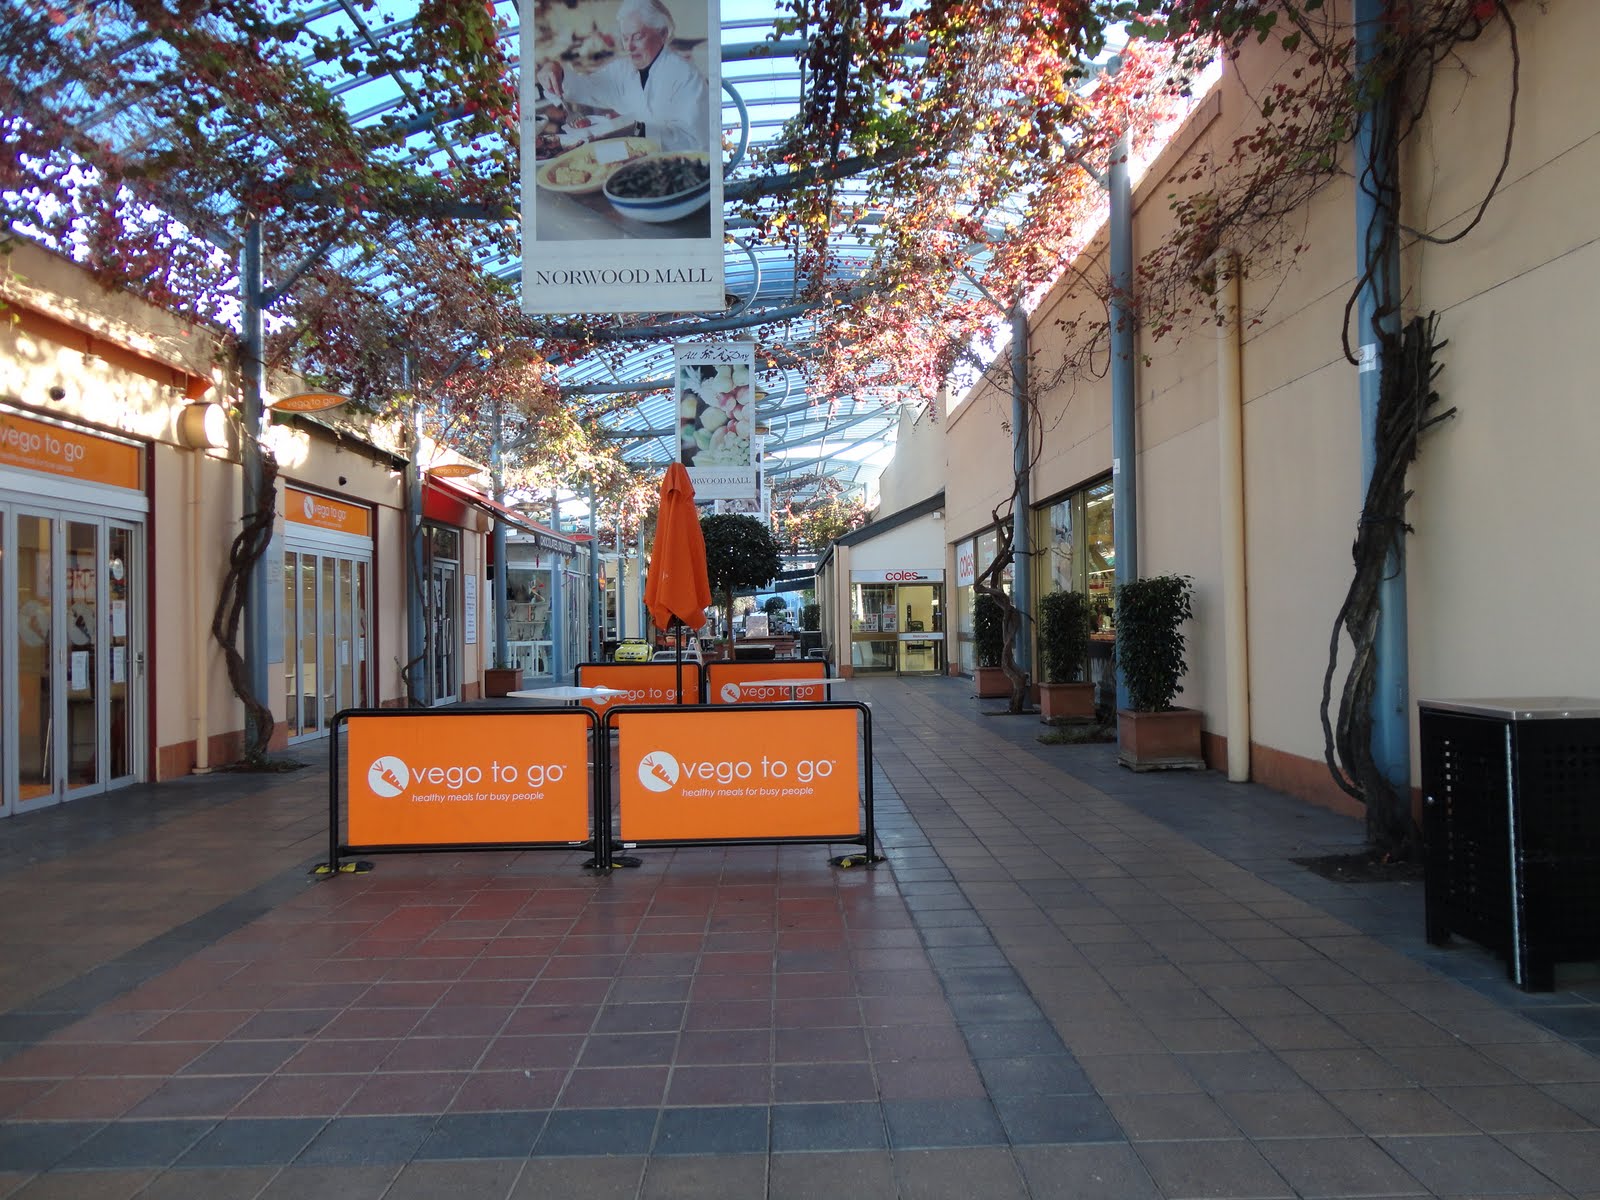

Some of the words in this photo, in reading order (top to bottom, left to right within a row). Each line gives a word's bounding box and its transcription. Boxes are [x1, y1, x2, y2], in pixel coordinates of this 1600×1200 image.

[536, 269, 650, 285] NORWOOD
[654, 267, 713, 284] MALL
[680, 350, 698, 360] All
[323, 397, 335, 407] go
[0, 426, 41, 453] vego
[45, 432, 61, 455] to
[64, 442, 84, 462] go
[691, 477, 727, 485] RWOOD
[727, 476, 752, 485] MALL
[314, 504, 330, 519] vego
[331, 505, 337, 518] to
[338, 509, 346, 522] go
[960, 550, 974, 578] coles
[885, 570, 919, 581] coles
[613, 689, 645, 701] ego
[649, 688, 662, 699] to
[741, 687, 775, 699] vego
[796, 686, 814, 698] go
[411, 766, 482, 789] vego
[491, 760, 518, 783] to
[527, 764, 564, 788] go
[682, 761, 752, 784] vego
[761, 755, 788, 778] to
[797, 759, 833, 783] go
[412, 793, 445, 803] healthy
[447, 792, 474, 802] meals
[475, 792, 487, 801] for
[489, 791, 510, 802] busy
[511, 791, 545, 801] people
[682, 788, 715, 799] healthy
[717, 787, 744, 797] meals
[745, 787, 757, 796] for
[759, 787, 780, 797] busy
[781, 786, 814, 797] people
